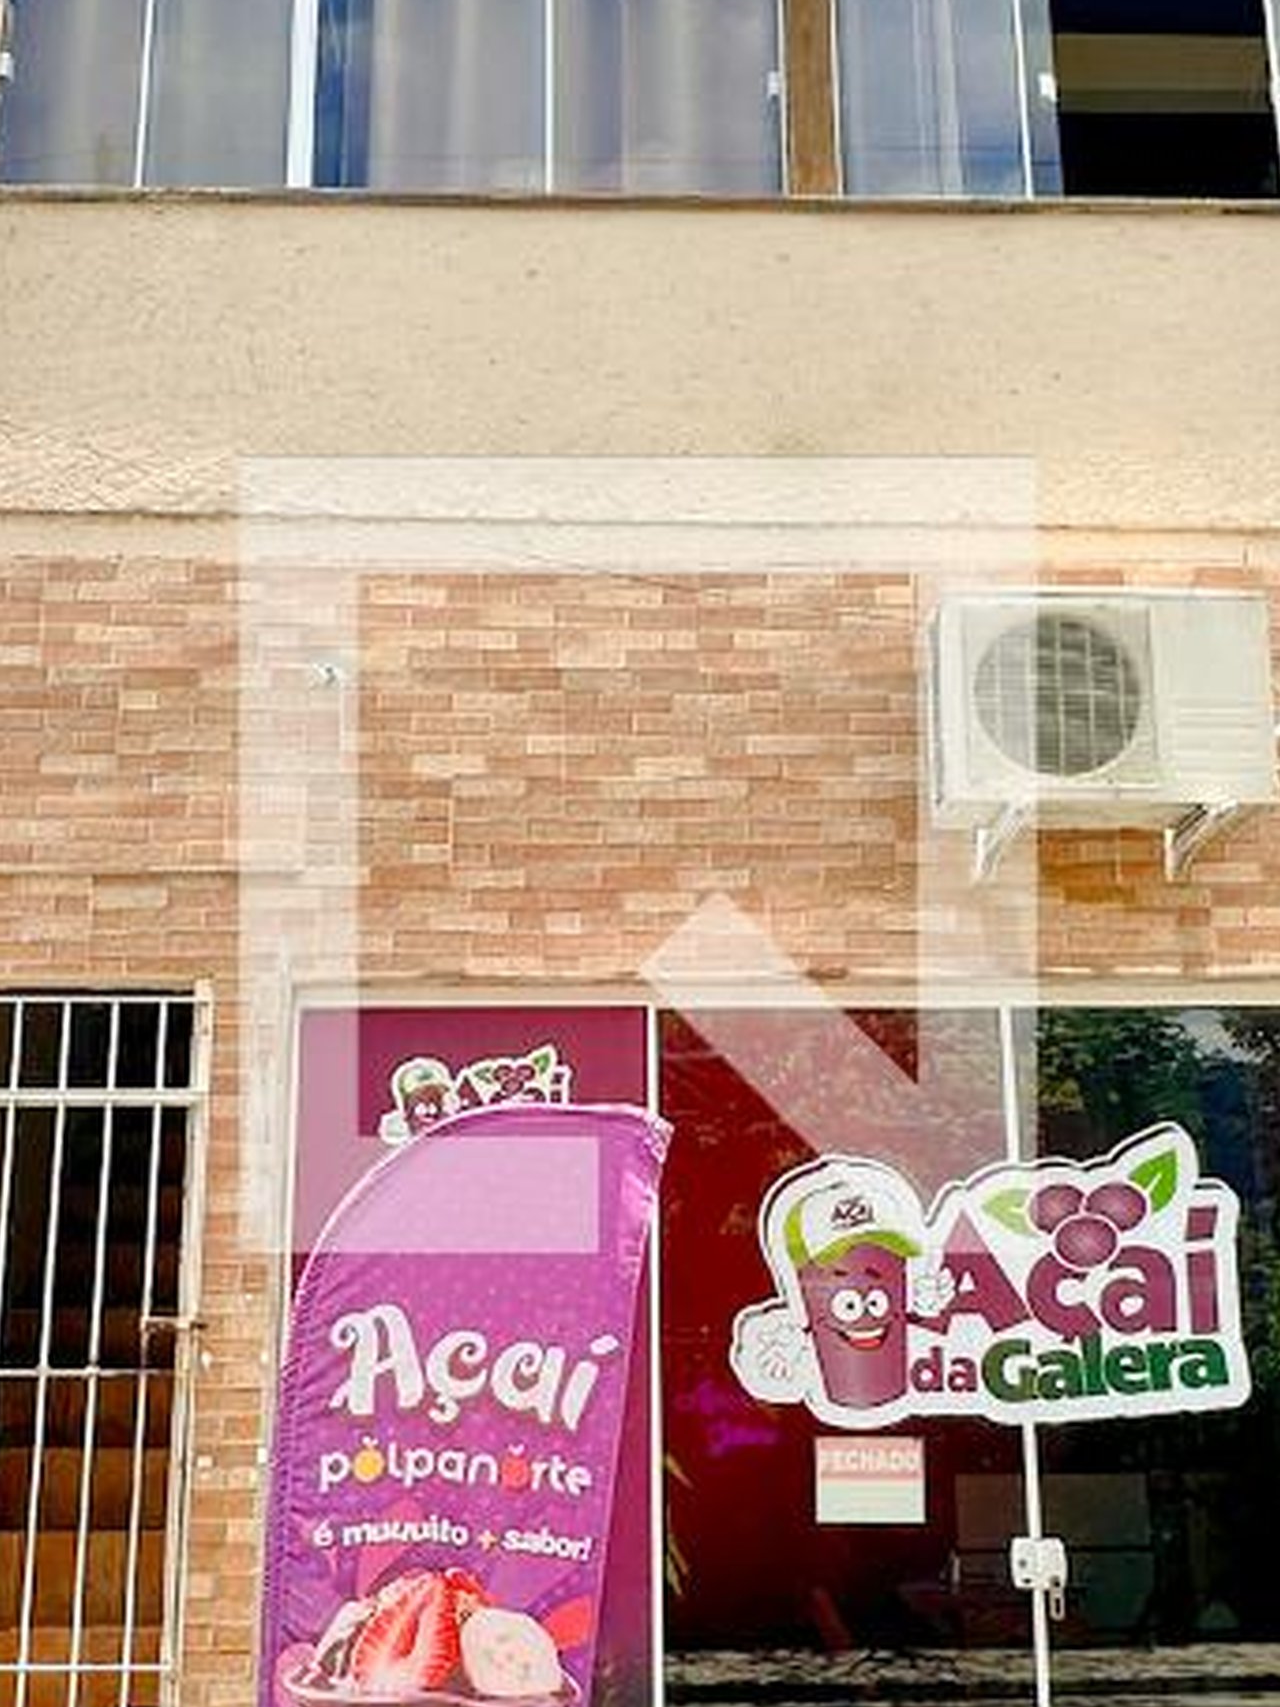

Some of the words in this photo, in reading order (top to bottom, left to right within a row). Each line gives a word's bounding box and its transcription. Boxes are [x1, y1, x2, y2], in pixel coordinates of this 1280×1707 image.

[329, 1303, 619, 1432] Açaí
[820, 1450, 920, 1472] FECHADO
[313, 1519, 333, 1547] é
